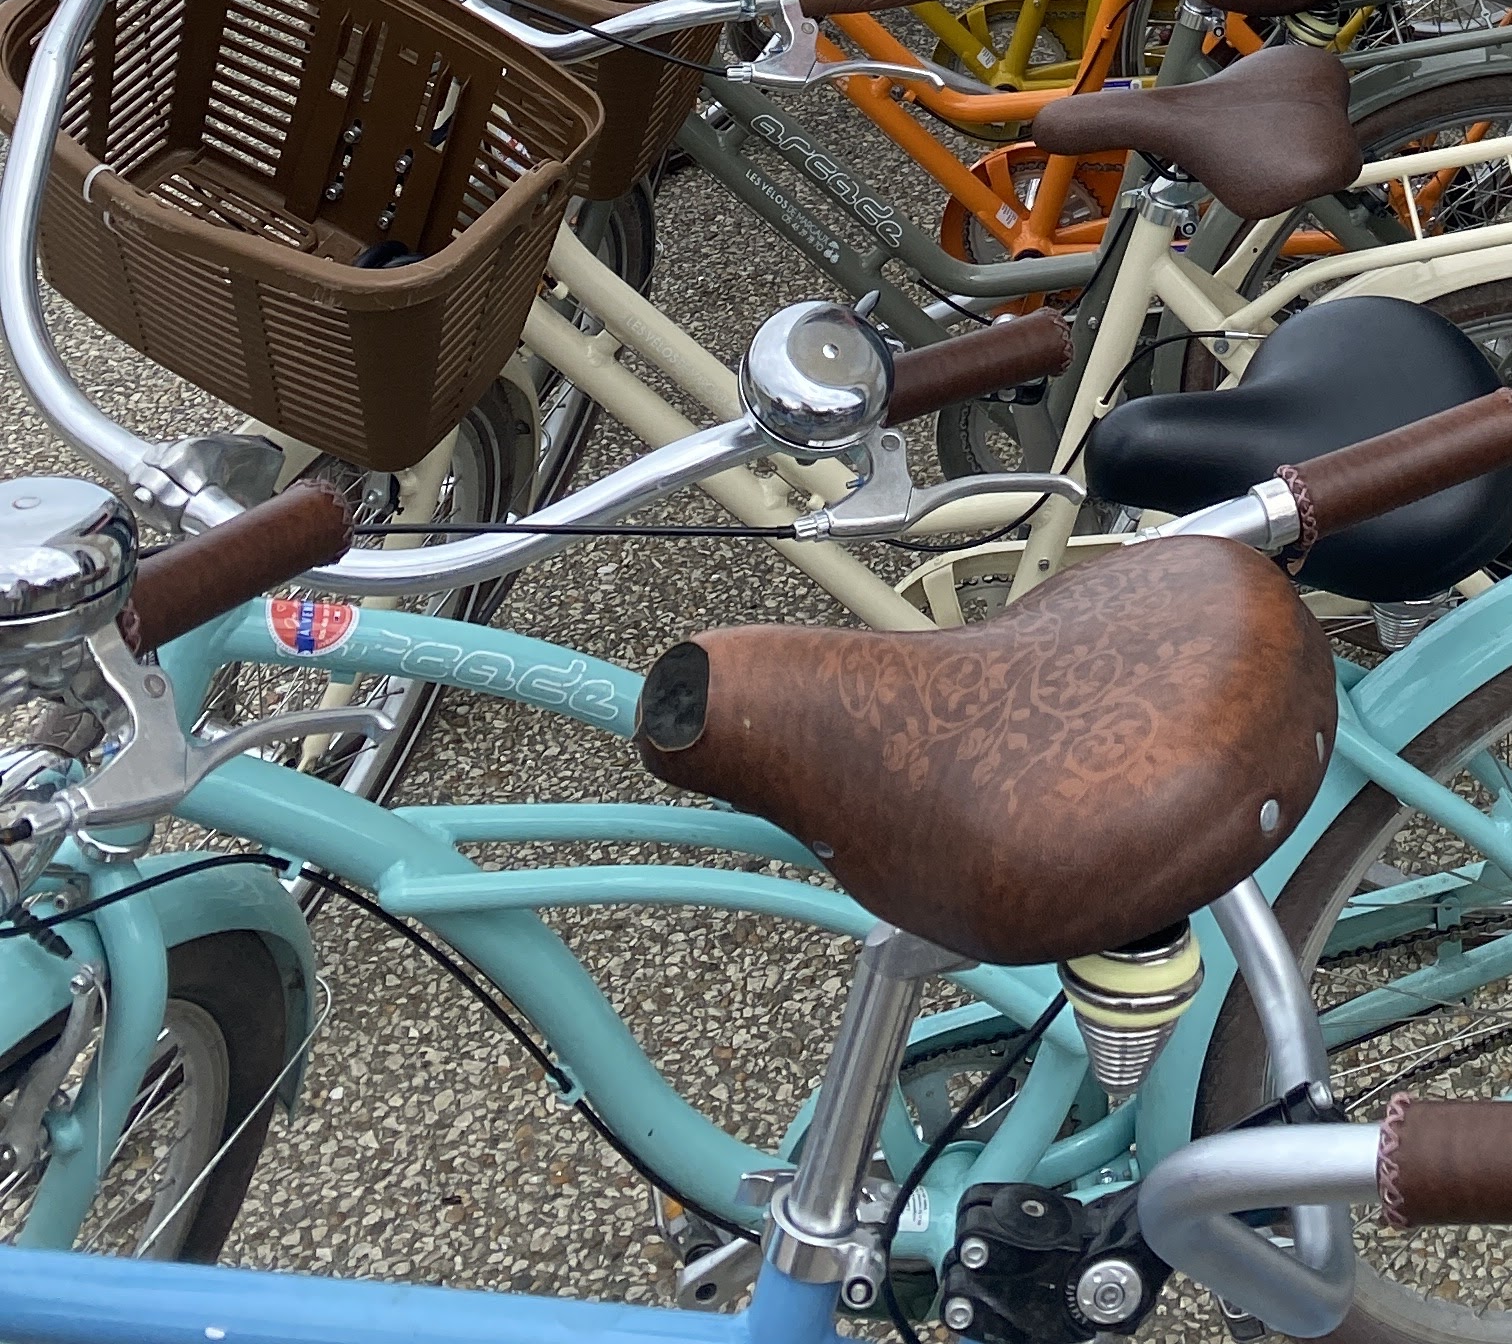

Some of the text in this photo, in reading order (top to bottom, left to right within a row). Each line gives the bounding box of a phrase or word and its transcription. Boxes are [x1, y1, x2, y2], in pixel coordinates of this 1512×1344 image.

[745, 169, 761, 186] LES
[762, 181, 789, 209] VÉLOS
[751, 114, 903, 248] arcade
[277, 630, 618, 721] rcade
